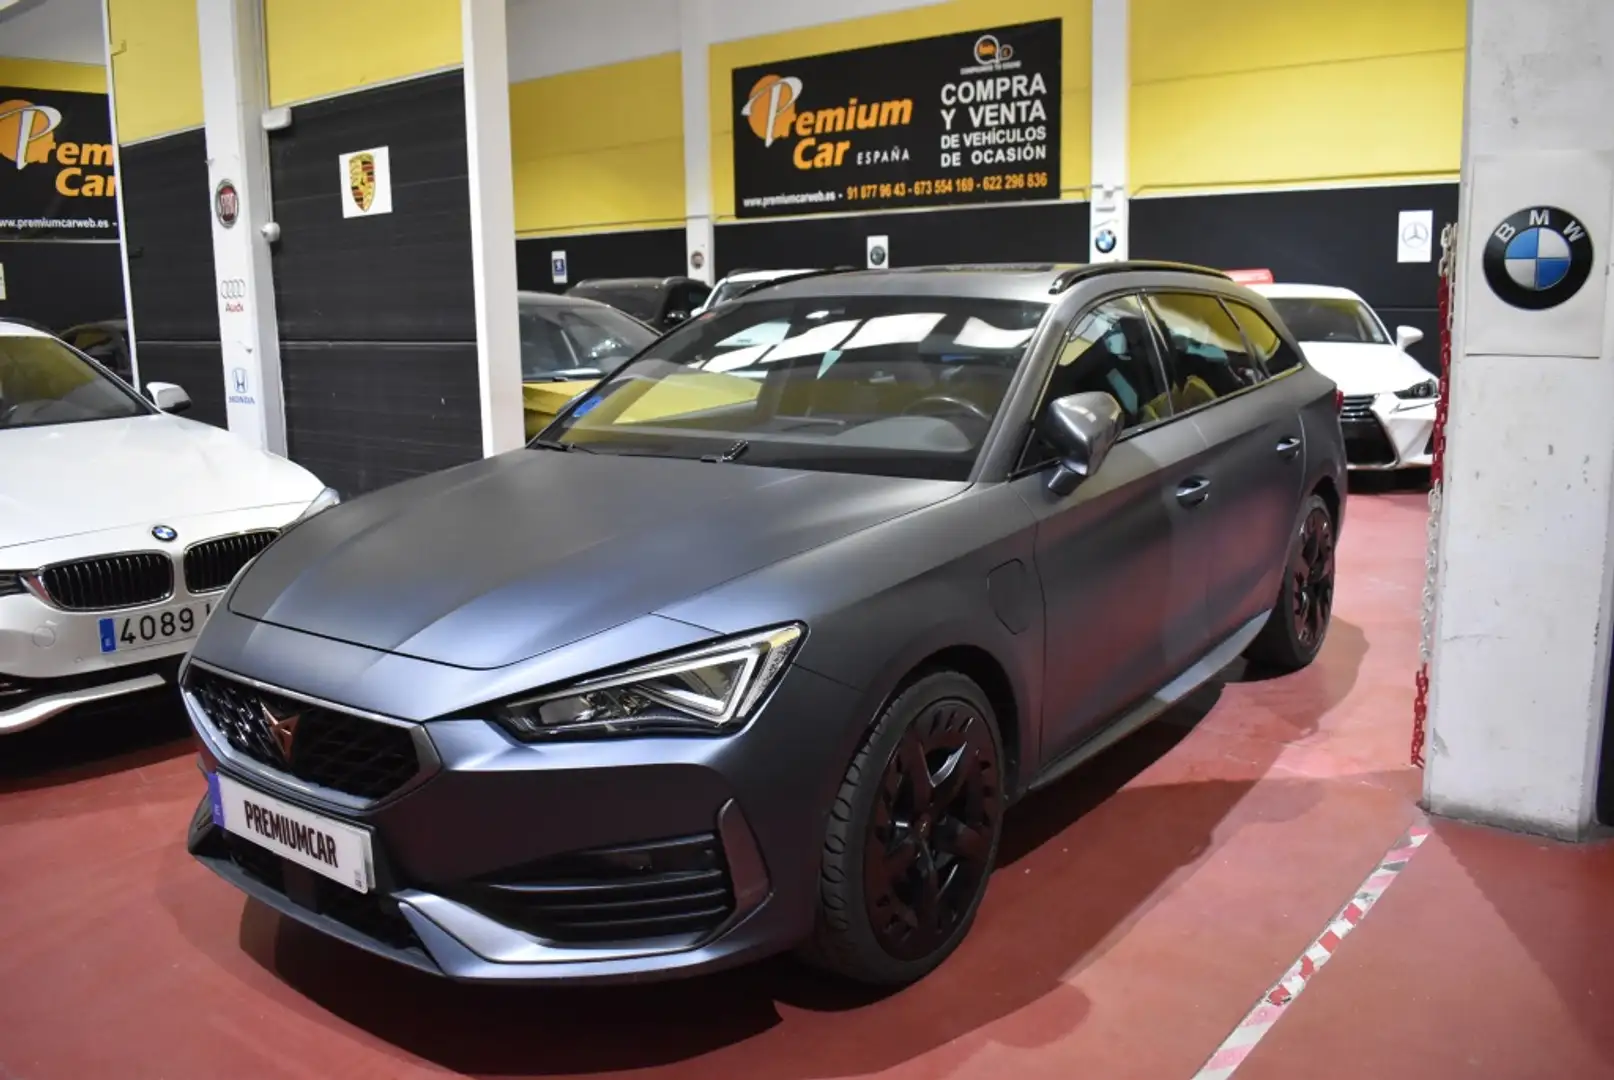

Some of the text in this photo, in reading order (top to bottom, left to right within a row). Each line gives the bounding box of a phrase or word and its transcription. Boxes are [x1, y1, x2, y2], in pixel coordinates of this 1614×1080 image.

[941, 72, 1047, 106] COMPRA
[741, 76, 913, 148] Premium
[941, 100, 1047, 131] Y VENTA
[793, 137, 910, 169] Car ESPAÑA
[941, 126, 1047, 150] DE VEHÍCULOS
[941, 142, 1047, 168] DE OCASIÓN
[847, 186, 859, 200] 91
[893, 182, 906, 197] 43
[914, 180, 932, 196] 673
[983, 175, 1003, 191] 622
[1494, 209, 1586, 243] BMW
[225, 301, 244, 312] Audi
[228, 395, 255, 404] HONDA
[120, 608, 194, 643] 4089
[243, 799, 338, 868] PREMIUMCAR
